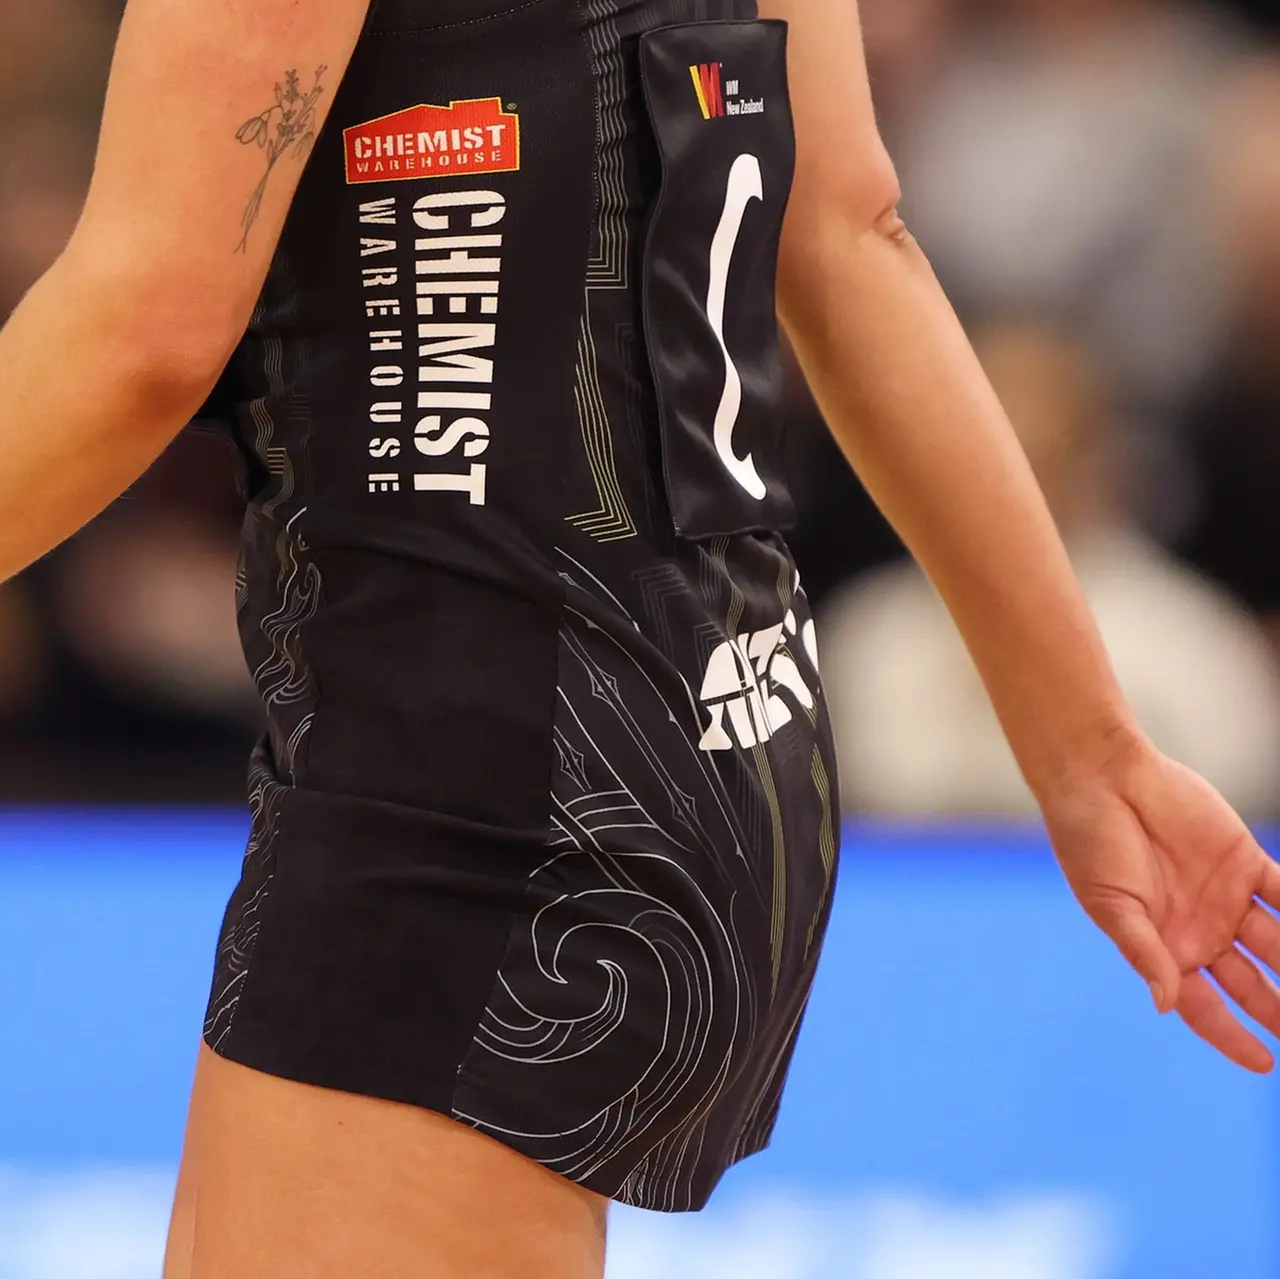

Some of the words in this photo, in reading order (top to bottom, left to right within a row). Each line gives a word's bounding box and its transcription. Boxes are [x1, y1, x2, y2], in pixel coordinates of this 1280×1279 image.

[725, 79, 739, 96] WM
[726, 100, 740, 116] New
[740, 97, 764, 115] Zealand
[354, 124, 506, 159] CHEMIST
[356, 149, 502, 173] WAREHOUSE
[358, 196, 404, 493] WAREHOUSE
[412, 190, 507, 505] CHEMIST
